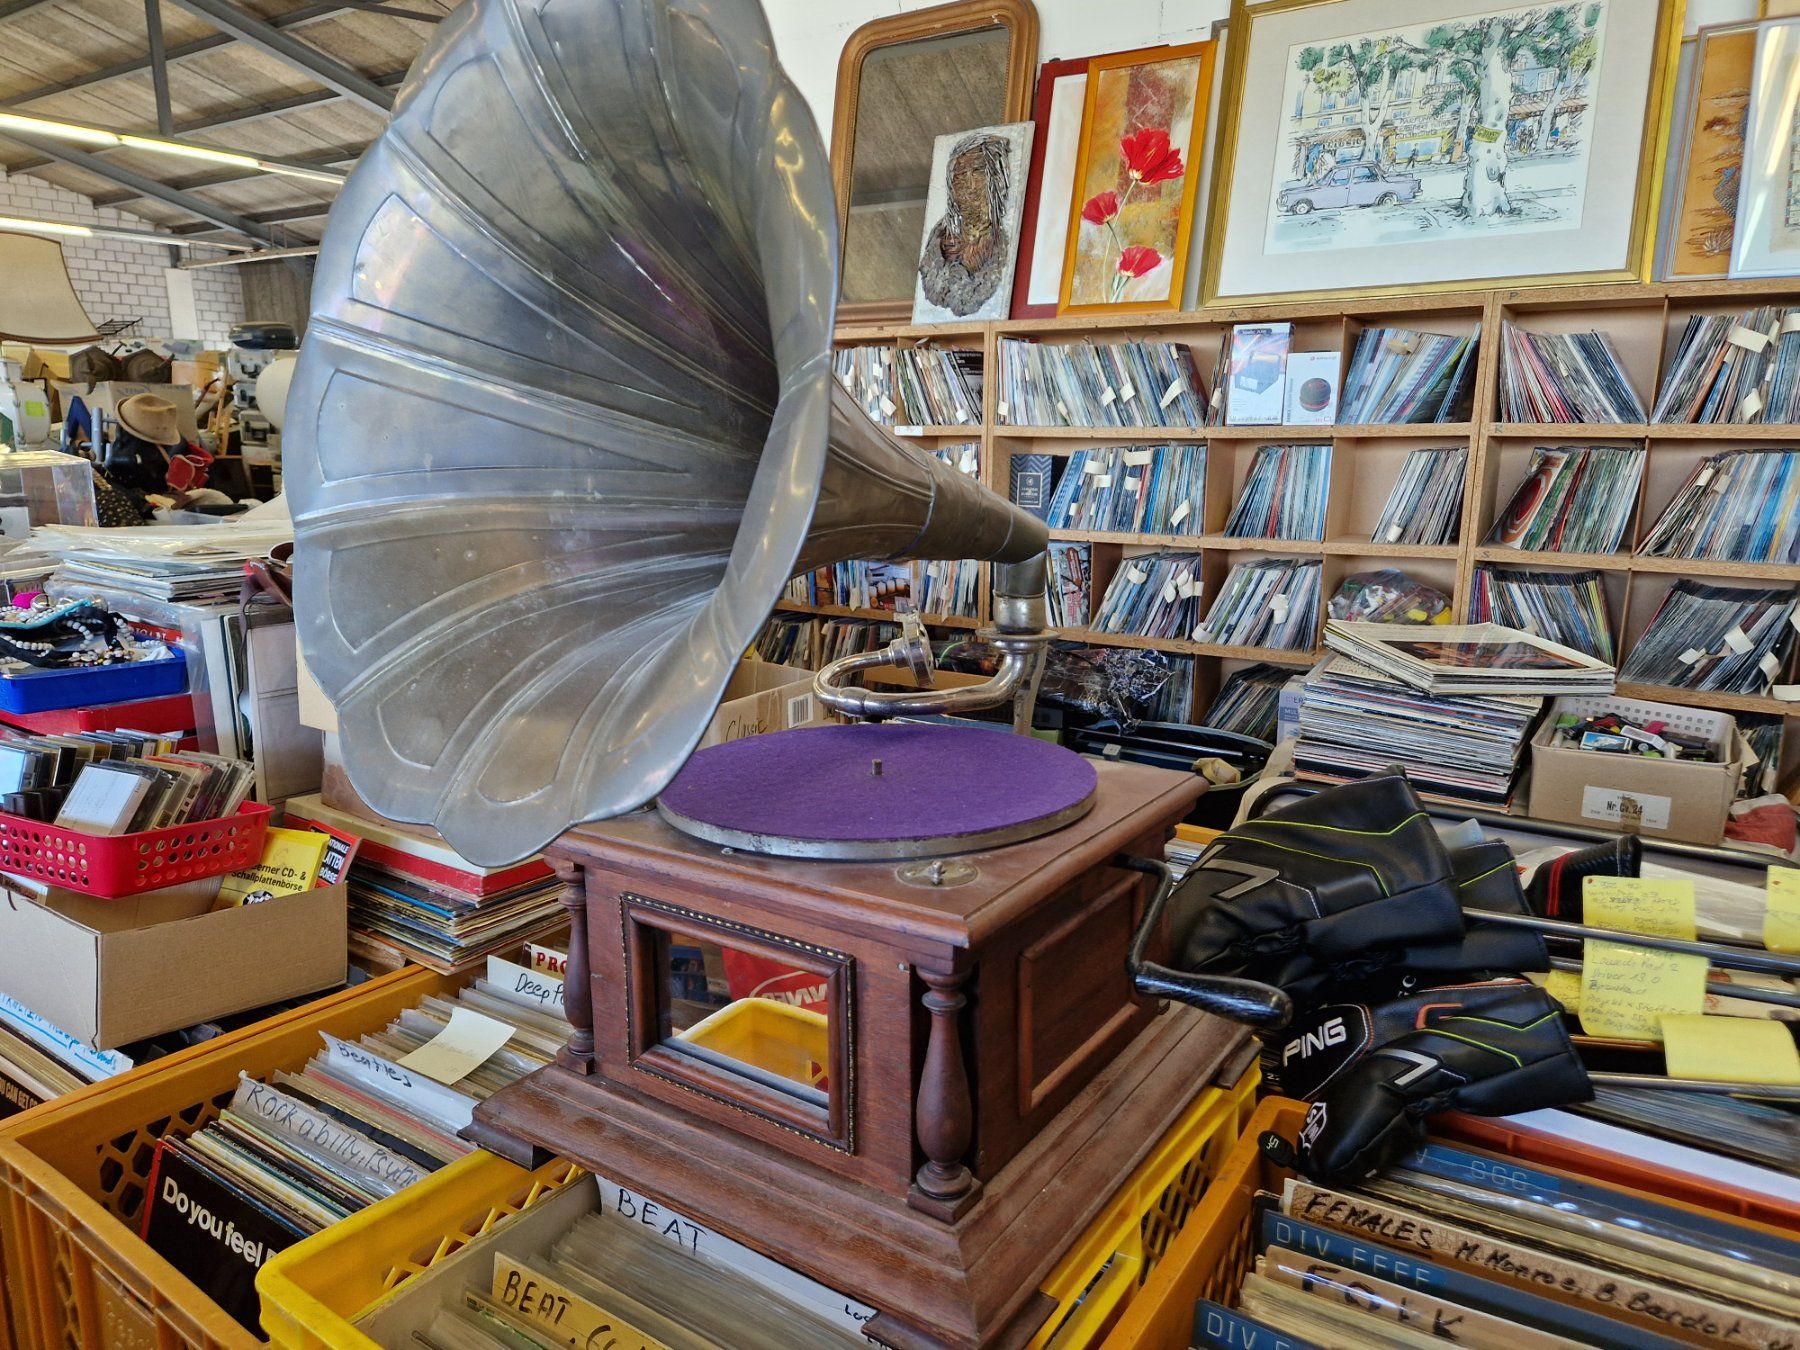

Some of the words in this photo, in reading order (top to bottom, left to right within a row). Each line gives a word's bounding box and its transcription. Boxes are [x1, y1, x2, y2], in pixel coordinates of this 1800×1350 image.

[514, 972, 550, 1004] Deep
[1283, 1016, 1347, 1067] PING
[162, 1175, 189, 1214] Do
[187, 1199, 224, 1240] you
[224, 1220, 264, 1268] feel
[617, 1188, 708, 1256] BEAT
[1304, 1192, 1433, 1250] FEMALES
[501, 1270, 572, 1326] BEAT
